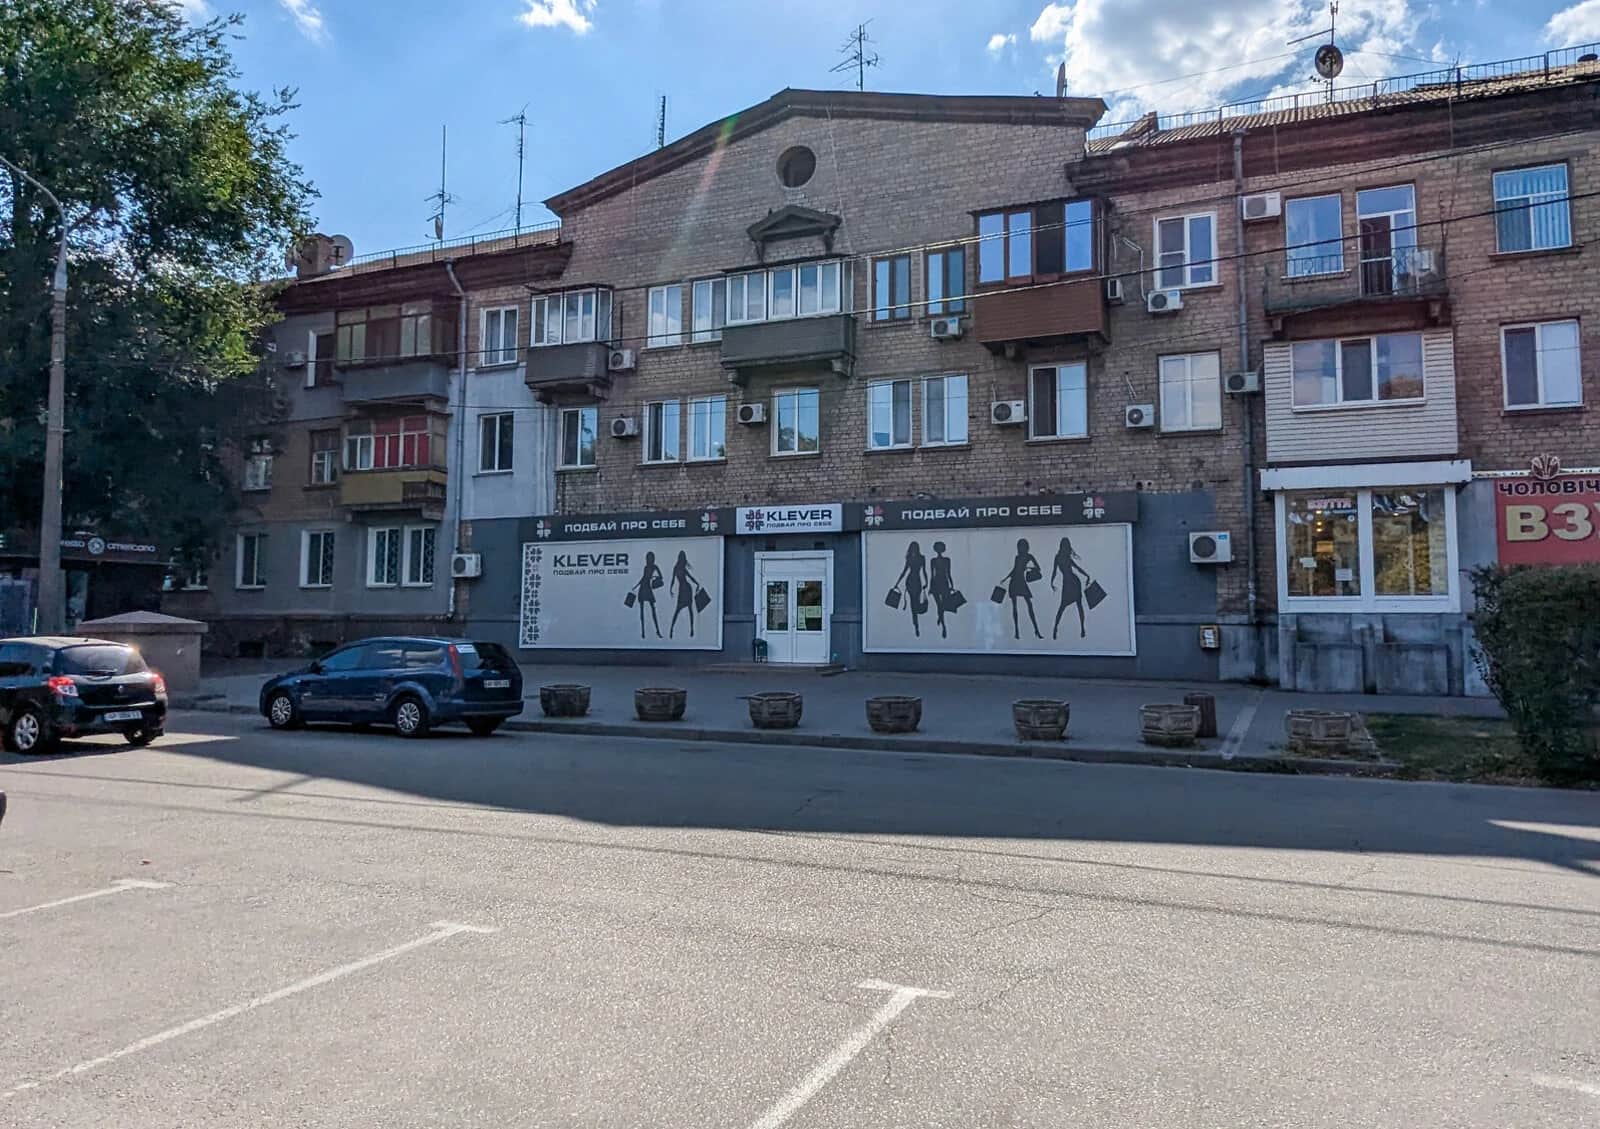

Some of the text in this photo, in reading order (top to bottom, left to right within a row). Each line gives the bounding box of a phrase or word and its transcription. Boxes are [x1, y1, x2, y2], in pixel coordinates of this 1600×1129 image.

[767, 509, 832, 521] KLEVER
[902, 505, 1062, 520] ПОДБАЙ ПРО СЕБЕ
[564, 519, 686, 533] ПОДБАЙ ПРО СЕБЕ
[1506, 503, 1600, 541] ВЗ
[553, 553, 629, 567] KLEVER
